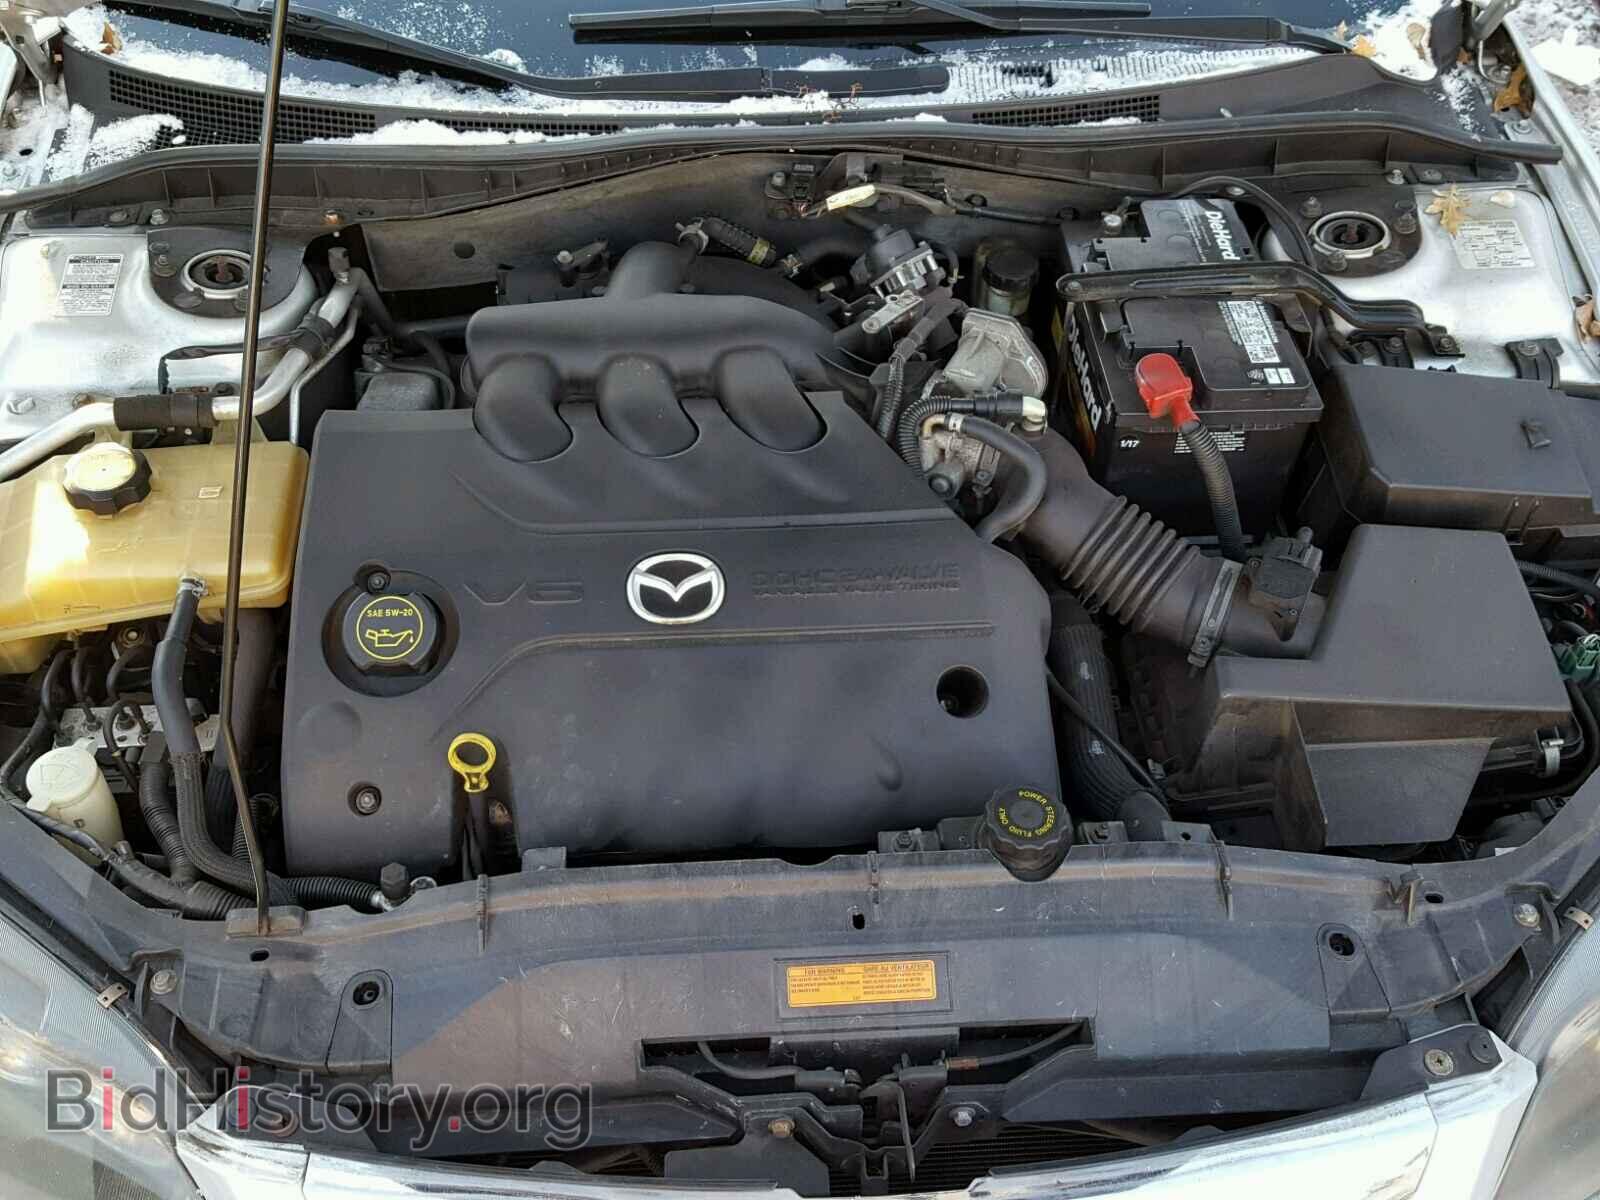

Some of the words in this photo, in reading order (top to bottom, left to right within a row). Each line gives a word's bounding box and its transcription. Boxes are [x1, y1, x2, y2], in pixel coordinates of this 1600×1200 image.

[1204, 210, 1241, 261] DieHard
[1119, 439, 1140, 449] 1/17
[366, 608, 384, 618] SAE
[385, 607, 414, 618] 5W-20
[1018, 790, 1048, 805] POWER
[998, 807, 1009, 825] ONLY
[1034, 806, 1056, 836] STEERING
[1008, 825, 1033, 838] FLUID
